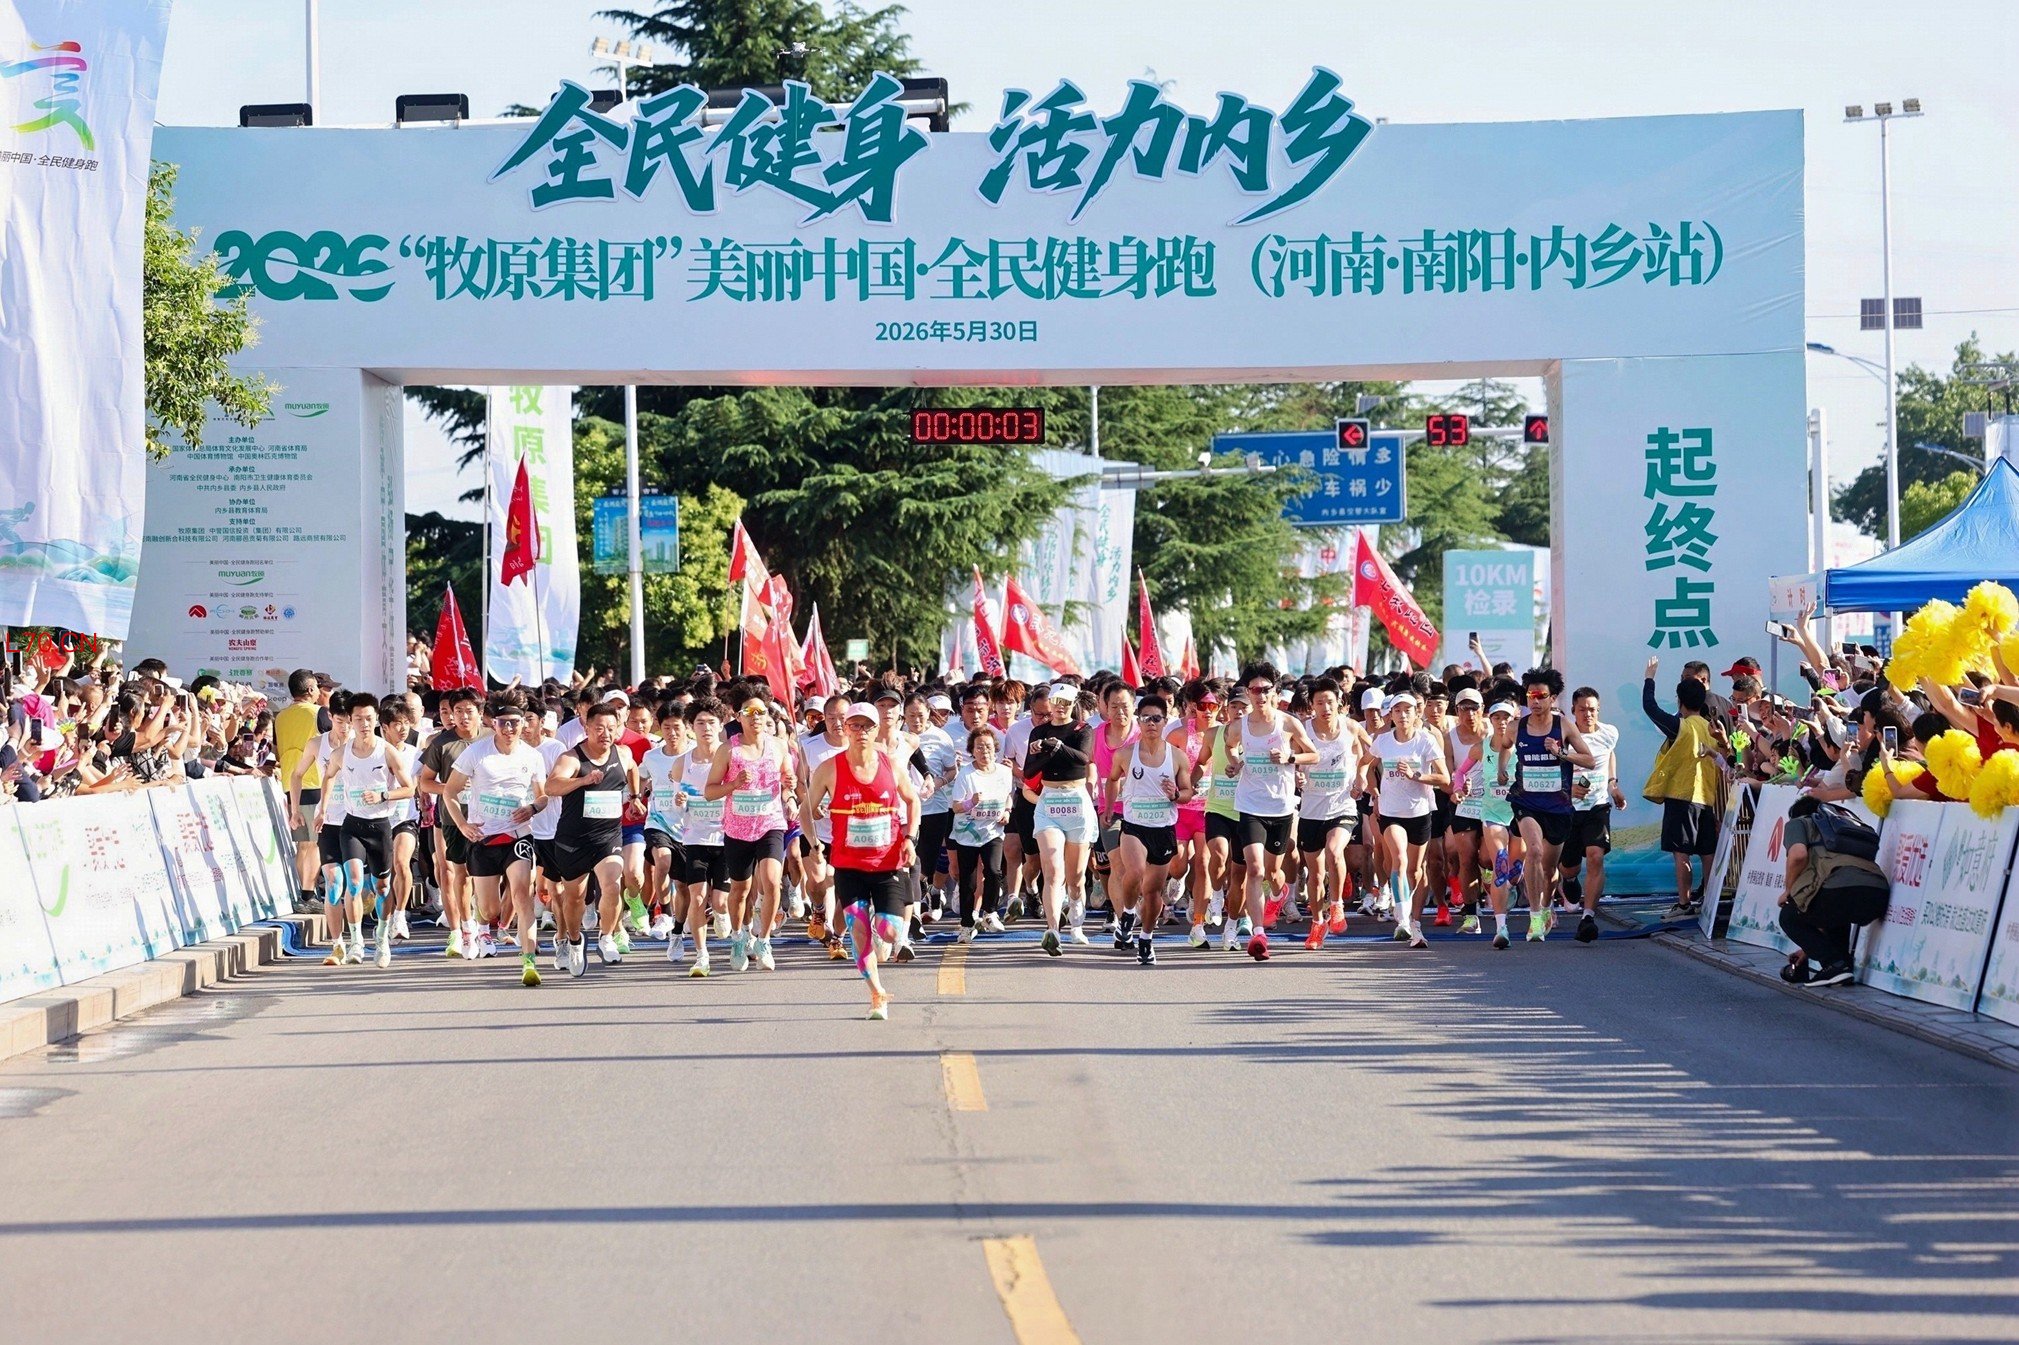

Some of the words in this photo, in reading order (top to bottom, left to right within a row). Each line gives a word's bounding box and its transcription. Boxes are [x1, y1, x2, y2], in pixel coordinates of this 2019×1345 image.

[489, 71, 931, 224] 全民健身
[975, 67, 1373, 226] 活力内乡
[0, 150, 99, 172] 丽中国·全民健身跑
[875, 320, 1038, 343] 2026年5月30日
[915, 412, 1038, 441] 00:00:03
[1429, 414, 1466, 446] 53
[228, 436, 255, 444] 主办单位
[267, 444, 308, 452] 河南省体育局
[228, 465, 256, 473] 承办单位
[169, 474, 230, 482] 河南省全民健身中心
[196, 484, 237, 492] 中共内乡县委
[1301, 477, 1392, 498] 车祸少
[228, 498, 256, 506] 协办单位
[1643, 426, 1719, 650] 起终点
[1455, 563, 1527, 587] 10KM
[1464, 588, 1518, 617] 检录
[228, 638, 257, 647] 农夫山泉
[1251, 766, 1279, 774] A0194
[1314, 780, 1341, 788] A0439
[483, 804, 511, 818] A0193
[693, 809, 720, 818] A0275
[1050, 806, 1077, 815] B0088
[1461, 807, 1481, 816] A032
[1137, 811, 1165, 820] A0202
